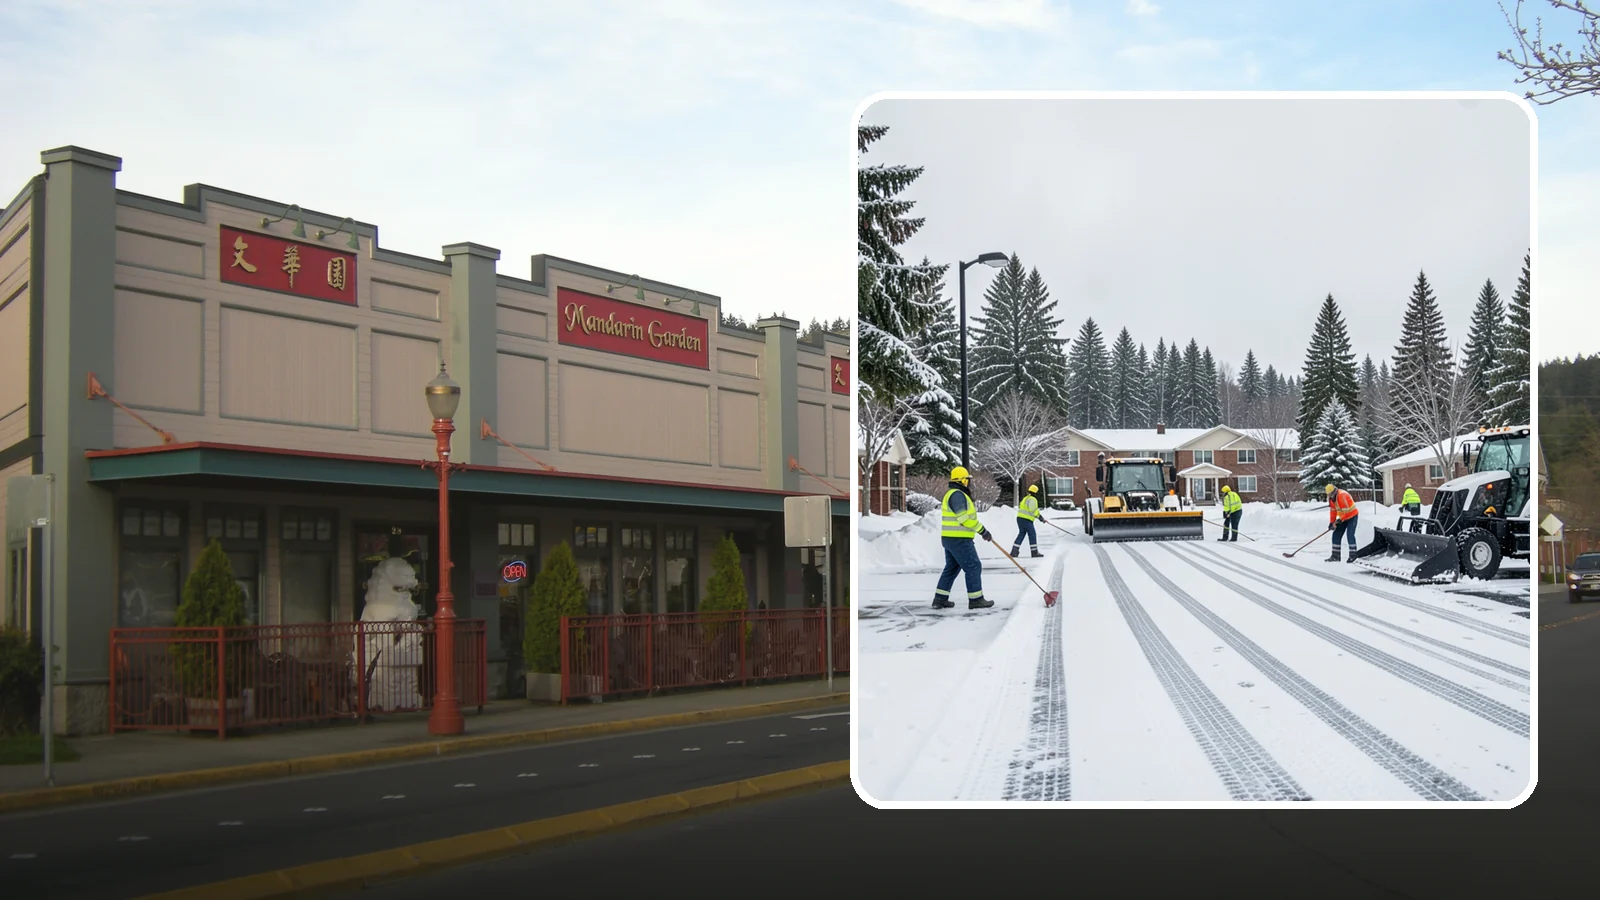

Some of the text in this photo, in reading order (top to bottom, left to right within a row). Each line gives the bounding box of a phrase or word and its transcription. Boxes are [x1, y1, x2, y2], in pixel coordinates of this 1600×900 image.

[231, 236, 346, 291] 文華園
[564, 302, 701, 352] Mandarin Garden
[503, 565, 527, 578] OPEN
